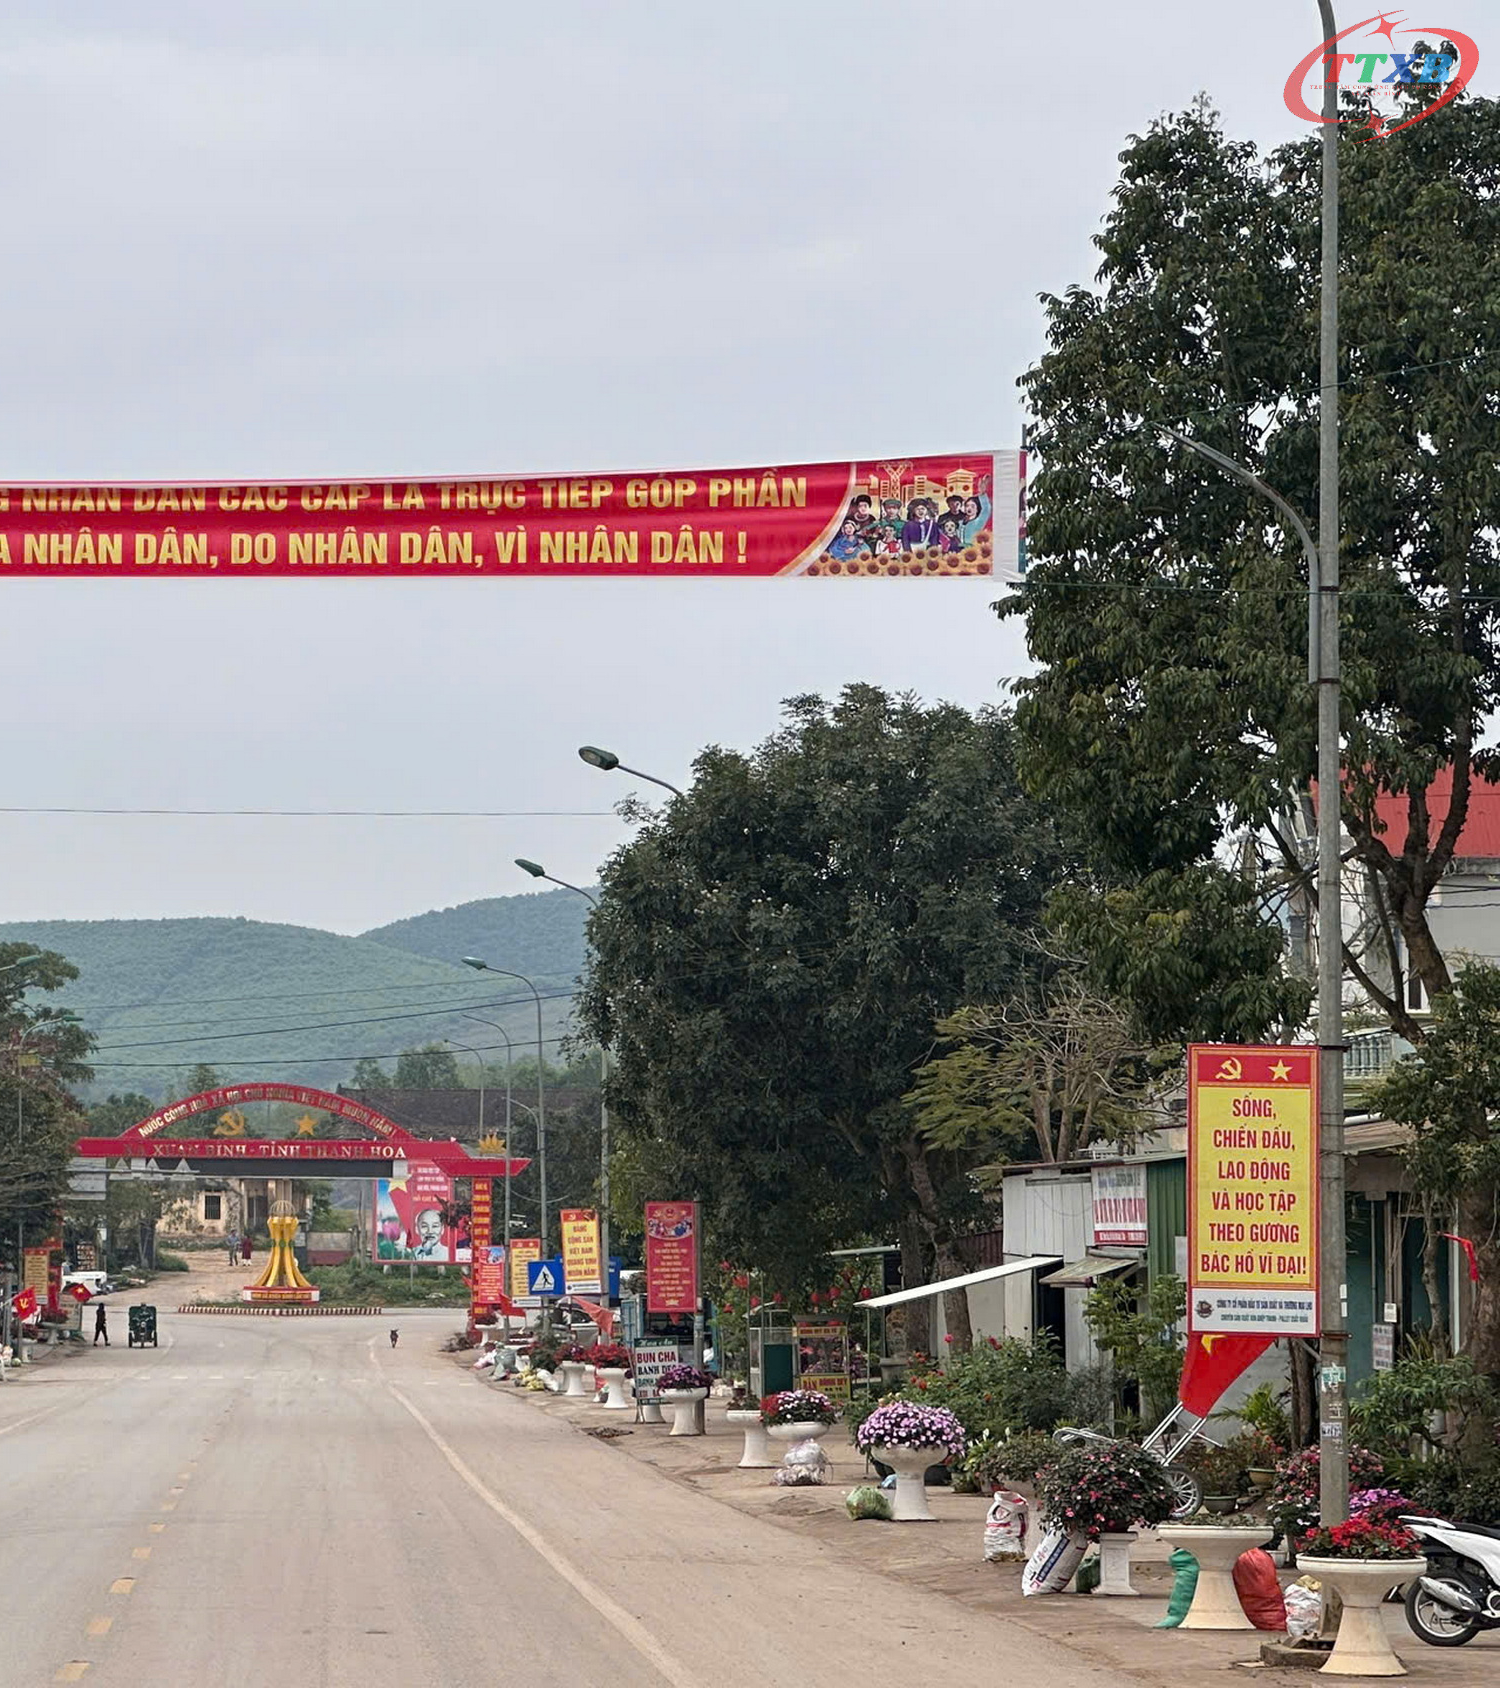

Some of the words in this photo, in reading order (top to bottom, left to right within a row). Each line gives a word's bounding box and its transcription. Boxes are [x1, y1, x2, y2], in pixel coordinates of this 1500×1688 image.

[709, 468, 808, 508] PHẦN
[23, 526, 122, 565] NHÂN
[134, 526, 219, 568] DÂN,
[230, 532, 277, 564] DO
[289, 525, 388, 564] NHÂN
[400, 525, 484, 568] DÂN,
[495, 525, 527, 563] VÌ
[541, 525, 639, 564] NHÂN
[651, 525, 724, 564] DÂN
[1232, 1092, 1276, 1120] SỐNG,
[1213, 1123, 1257, 1148] CHIẾN
[1262, 1123, 1295, 1152] ĐẤU,
[1218, 1160, 1245, 1179] LAO
[1250, 1157, 1290, 1184] ĐỘNG
[1212, 1187, 1230, 1210] VÀ
[1235, 1192, 1264, 1215] HỌC
[1269, 1189, 1296, 1216] TẬP
[1209, 1223, 1245, 1242] THEO
[1250, 1222, 1300, 1243] GƯƠNG
[1201, 1250, 1230, 1273] BÁC
[1235, 1248, 1254, 1273] HỒ
[1259, 1251, 1272, 1274] VĨ
[1277, 1255, 1306, 1279] ĐẠI!
